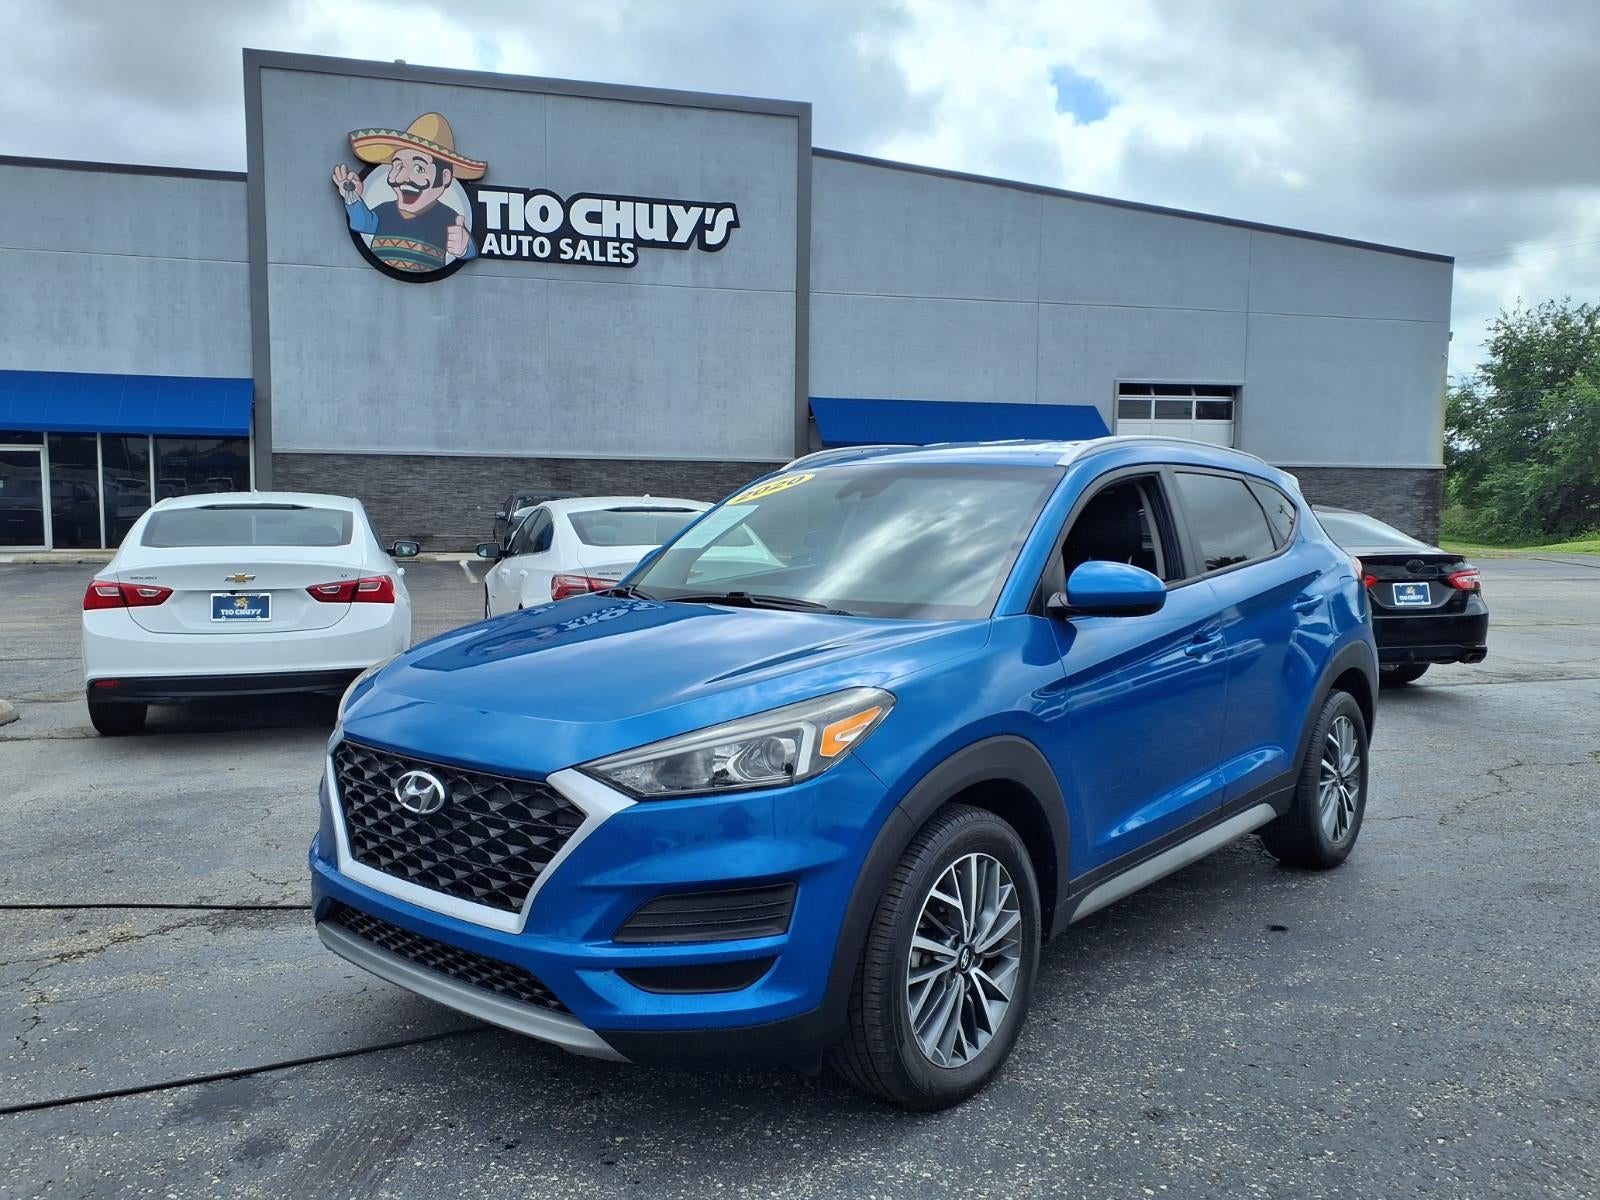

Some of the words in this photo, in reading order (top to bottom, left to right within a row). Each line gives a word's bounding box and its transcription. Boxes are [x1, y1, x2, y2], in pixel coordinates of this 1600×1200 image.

[478, 190, 564, 233] TIO
[569, 198, 735, 245] CHUY'S
[481, 233, 550, 258] AUTO
[559, 238, 635, 263] SALES
[734, 475, 806, 503] 2020
